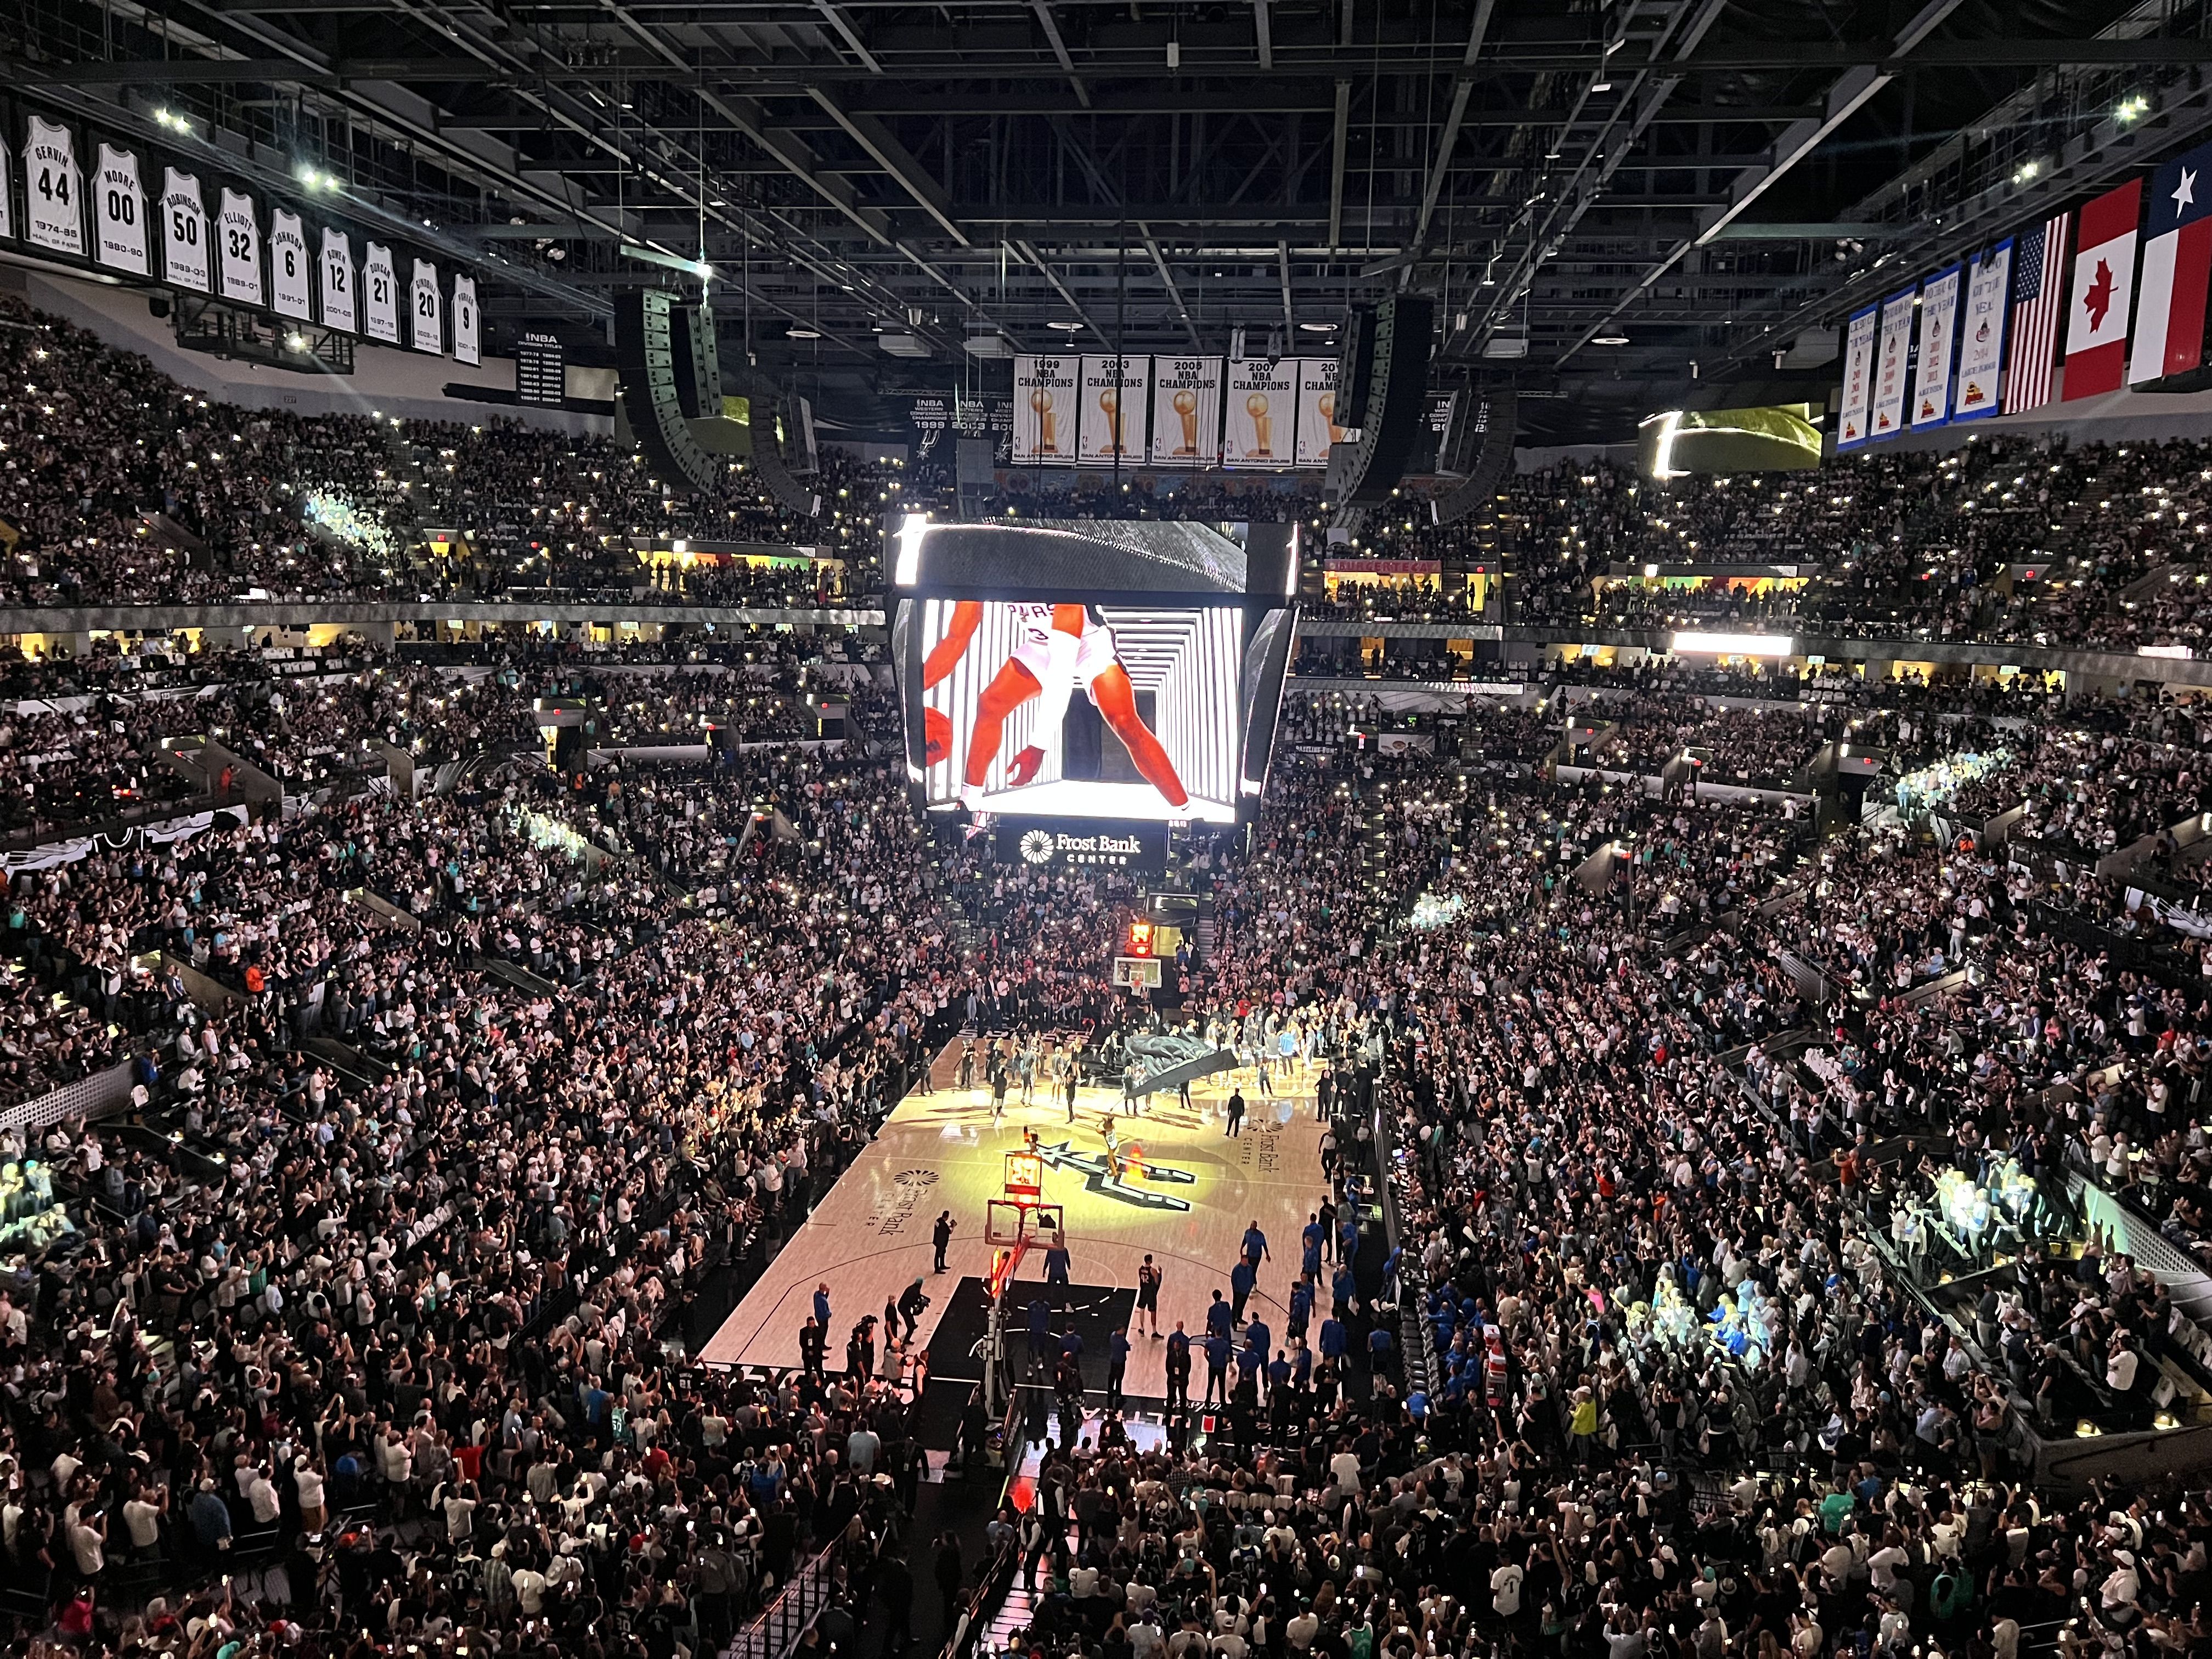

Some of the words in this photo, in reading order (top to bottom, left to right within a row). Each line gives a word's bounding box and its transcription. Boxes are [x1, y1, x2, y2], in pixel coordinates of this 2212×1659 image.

[36, 146, 68, 167] GERVIN
[38, 167, 69, 206] 44
[104, 170, 134, 191] MOORE
[108, 190, 134, 225] 00
[167, 194, 201, 217] ROBINSON
[35, 221, 77, 238] 1974-85
[173, 210, 197, 246] 50
[224, 212, 253, 232] ELLIOTT
[104, 240, 143, 257] 1980-90
[229, 229, 251, 262] 32
[275, 232, 303, 252] JOHNSON
[285, 250, 295, 278] 6
[370, 263, 391, 279] DUNCAN
[330, 264, 345, 292] 12
[278, 292, 306, 306] 1991-01
[374, 277, 388, 304] 21
[419, 291, 434, 318] 20
[463, 307, 469, 329] 9
[531, 334, 557, 343] NBA
[1034, 360, 1059, 369] 1999
[1036, 369, 1056, 378] NBA
[1174, 362, 1202, 370] 2005
[1248, 363, 1276, 371] 2007
[1321, 363, 1339, 372] 20
[1018, 377, 1073, 387] CHAMPIONS
[1160, 379, 1215, 390] CHAMPIONS
[1178, 371, 1197, 380] NBA
[1252, 373, 1271, 381] NBA
[1325, 373, 1338, 381] NB
[1233, 381, 1290, 391] CHAMPIONS
[1056, 833, 1097, 851] Frost
[1099, 834, 1141, 853] Bank
[1067, 854, 1126, 865] CENTER
[1242, 1138, 1252, 1164] CENTER
[1261, 1134, 1279, 1152] Frost
[1259, 1153, 1279, 1172] Bank
[878, 1211, 913, 1236] Bank
